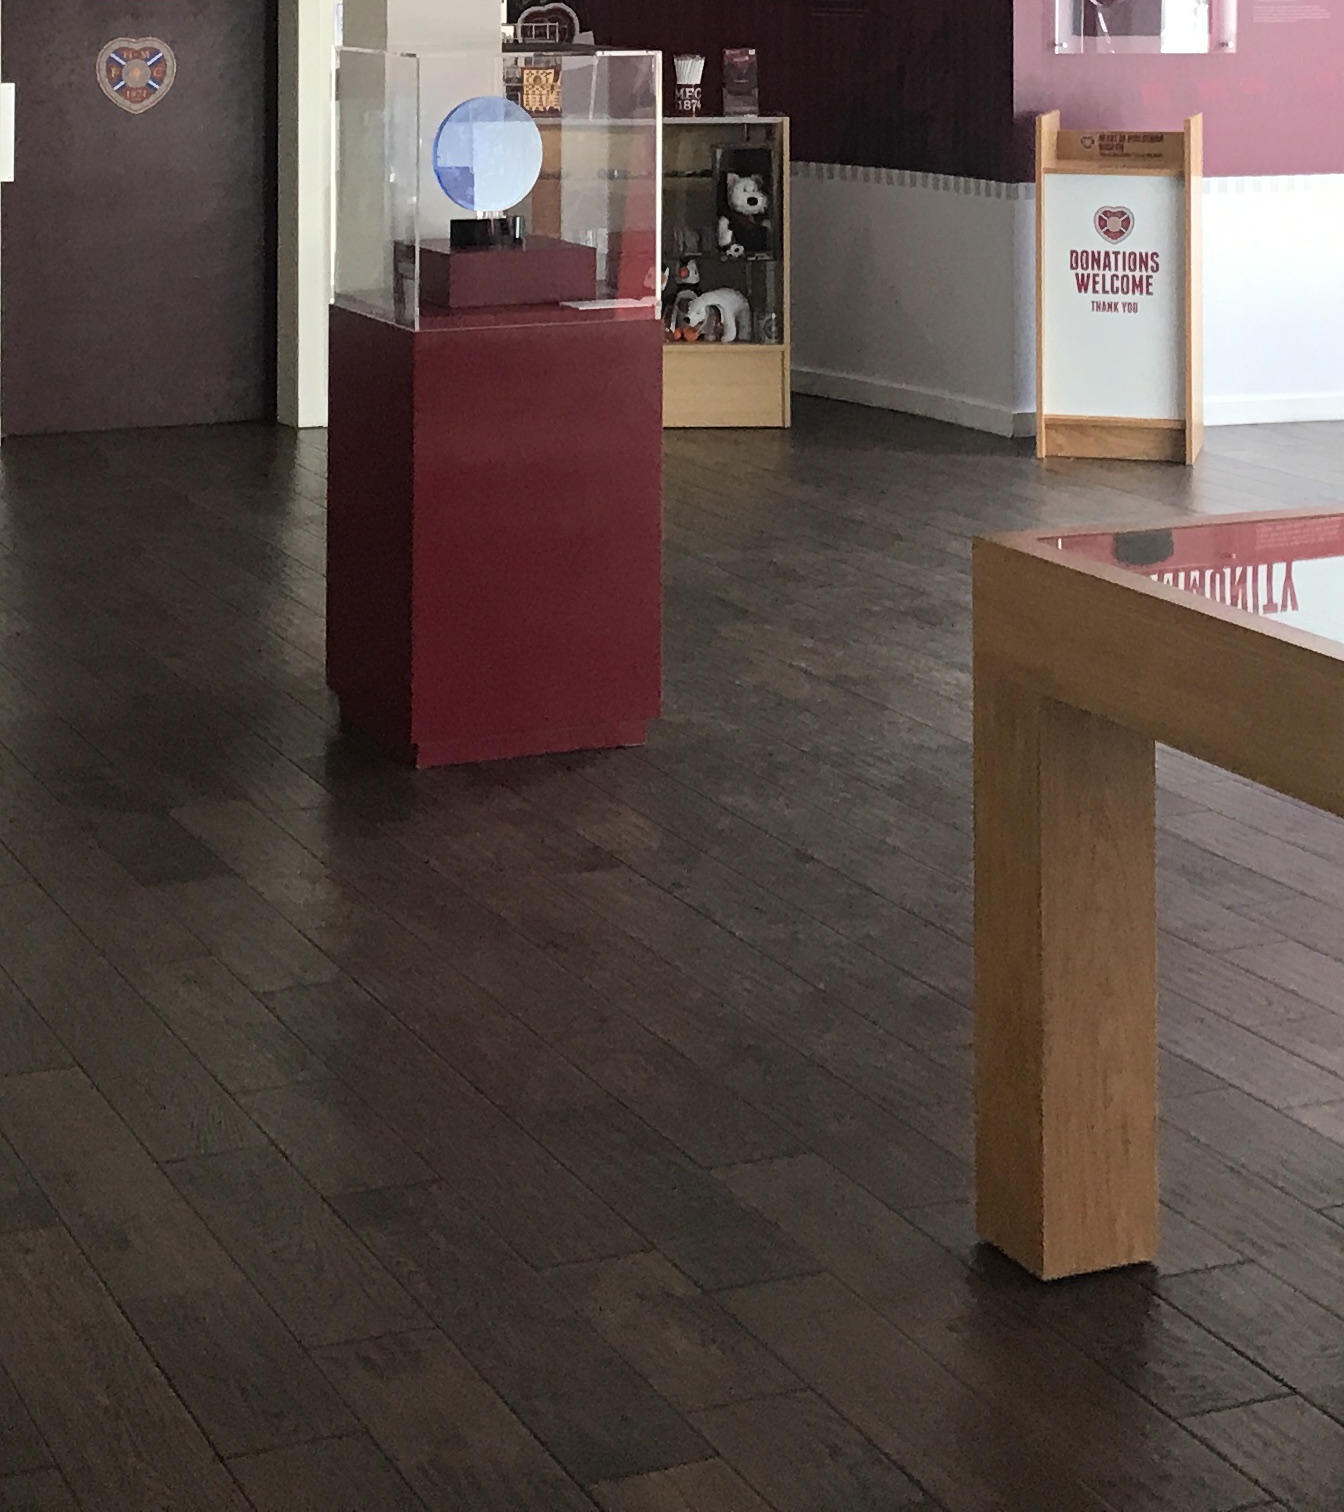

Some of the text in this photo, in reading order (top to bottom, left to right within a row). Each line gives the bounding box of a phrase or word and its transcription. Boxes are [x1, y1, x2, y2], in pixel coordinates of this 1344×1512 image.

[1070, 249, 1160, 273] DONATIONS
[1075, 273, 1154, 296] WELCOME
[1091, 300, 1139, 314] THANK YOU
